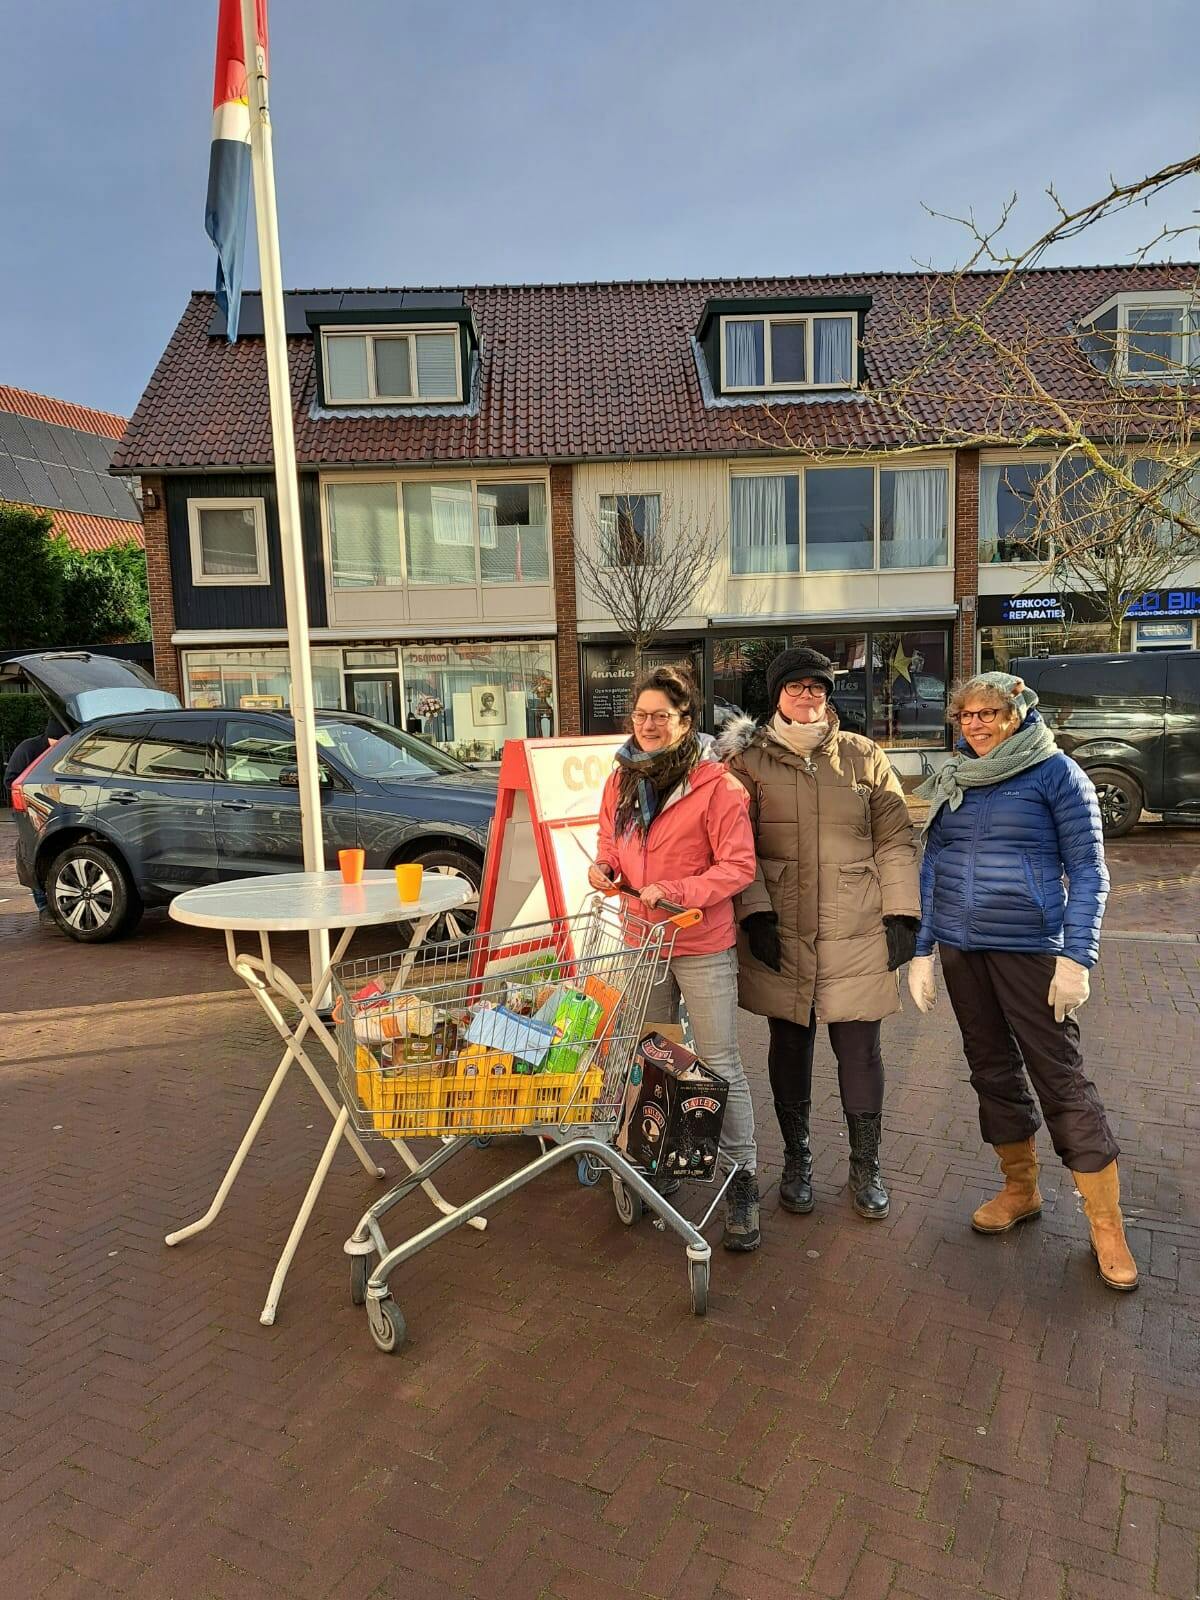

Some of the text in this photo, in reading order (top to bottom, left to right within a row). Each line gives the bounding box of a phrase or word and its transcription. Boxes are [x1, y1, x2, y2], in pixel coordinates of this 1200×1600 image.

[1009, 598, 1056, 608] VERKOOP
[1008, 608, 1065, 620] REPARATIES
[562, 754, 608, 791] CO
[683, 1098, 718, 1111] BAILEYS
